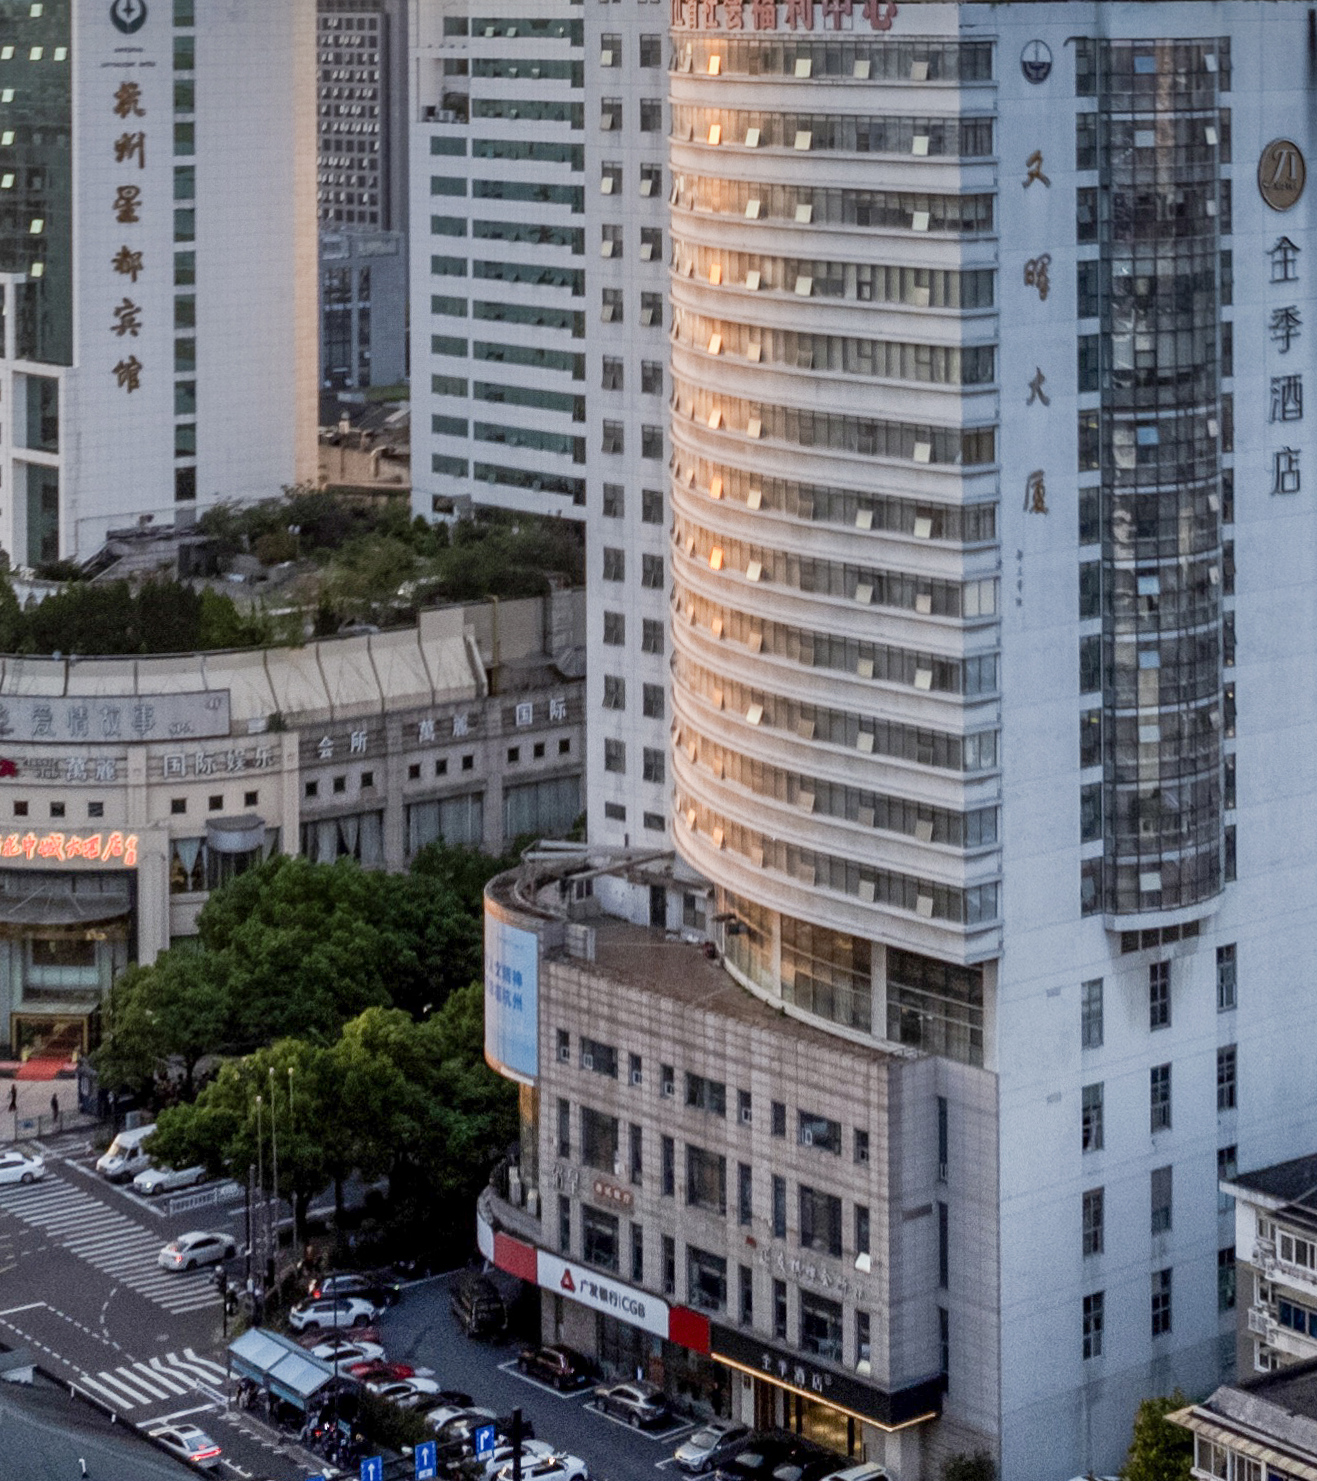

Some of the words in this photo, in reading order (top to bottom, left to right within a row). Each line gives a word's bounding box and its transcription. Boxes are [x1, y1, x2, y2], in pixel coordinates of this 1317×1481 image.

[1266, 235, 1304, 497] 全季酒店
[621, 1295, 646, 1319] CGB
